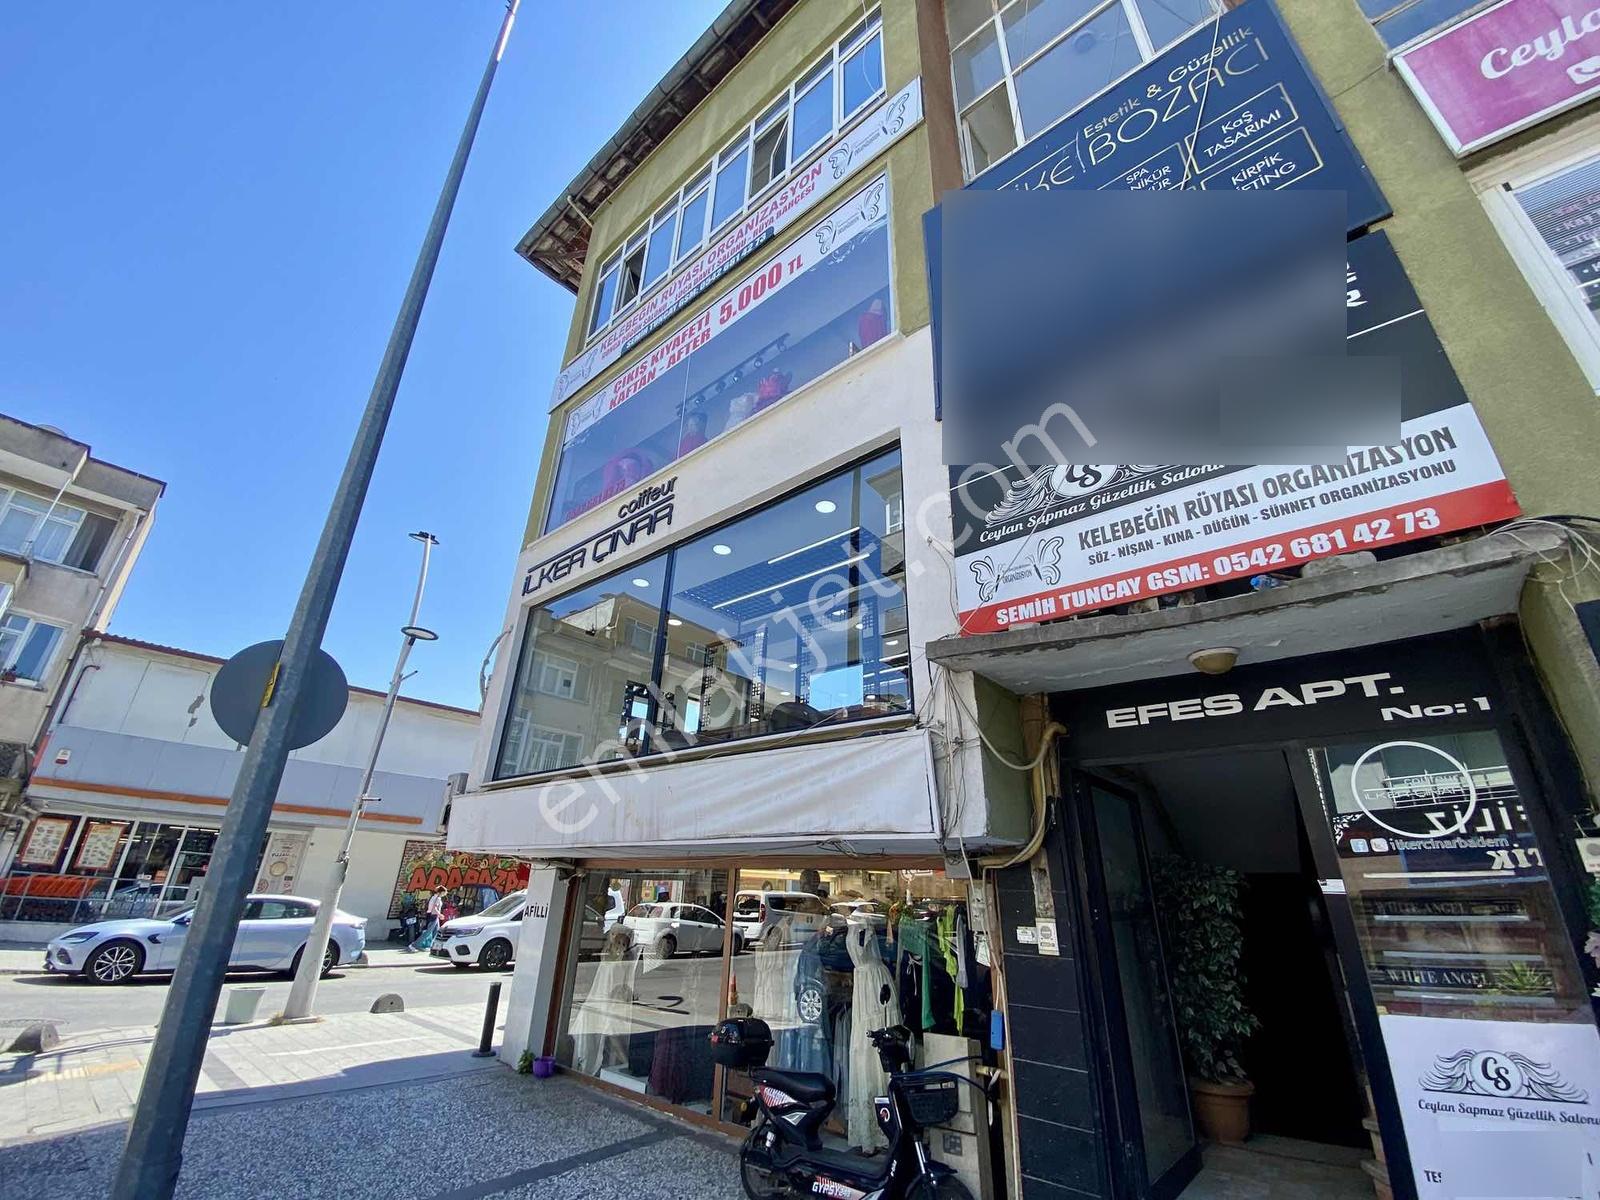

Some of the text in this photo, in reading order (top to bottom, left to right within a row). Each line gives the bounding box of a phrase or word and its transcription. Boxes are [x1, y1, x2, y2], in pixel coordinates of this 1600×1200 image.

[1083, 27, 1254, 139] Estetik & Güzellik
[1088, 36, 1270, 166] BOZACI
[1203, 109, 1281, 158] TASARIMI
[1126, 167, 1149, 185] SPA
[1231, 151, 1284, 187] KİRPİK
[707, 162, 823, 265] ORGANİZASYON
[651, 310, 711, 368] KIYAFETİ
[719, 261, 783, 326] 5.000
[787, 254, 804, 275] TL
[608, 327, 711, 411] KAFTAN AFTER
[617, 476, 678, 519] coiffeur
[979, 522, 1024, 544] Ceylan
[1026, 502, 1087, 529] Sapmaz
[1089, 479, 1156, 509] Güzellik
[1078, 504, 1180, 551] KELEBEĞİN
[1186, 484, 1256, 521] RÜYASI
[1088, 458, 1457, 566] SÖZ NİŞAN KINA DÜĞÜN SÜNNET ORGANİZASYONU
[996, 507, 1441, 625] SEMİH TUNCAY GSM: 0542 681 42 73
[1105, 672, 1405, 729] EFES APT.
[1386, 968, 1493, 987] WHITE ANGEL
[1418, 1099, 1456, 1114] Ceylan
[1458, 1103, 1505, 1118] Sapmaz
[1506, 1107, 1557, 1122] Güzellik
